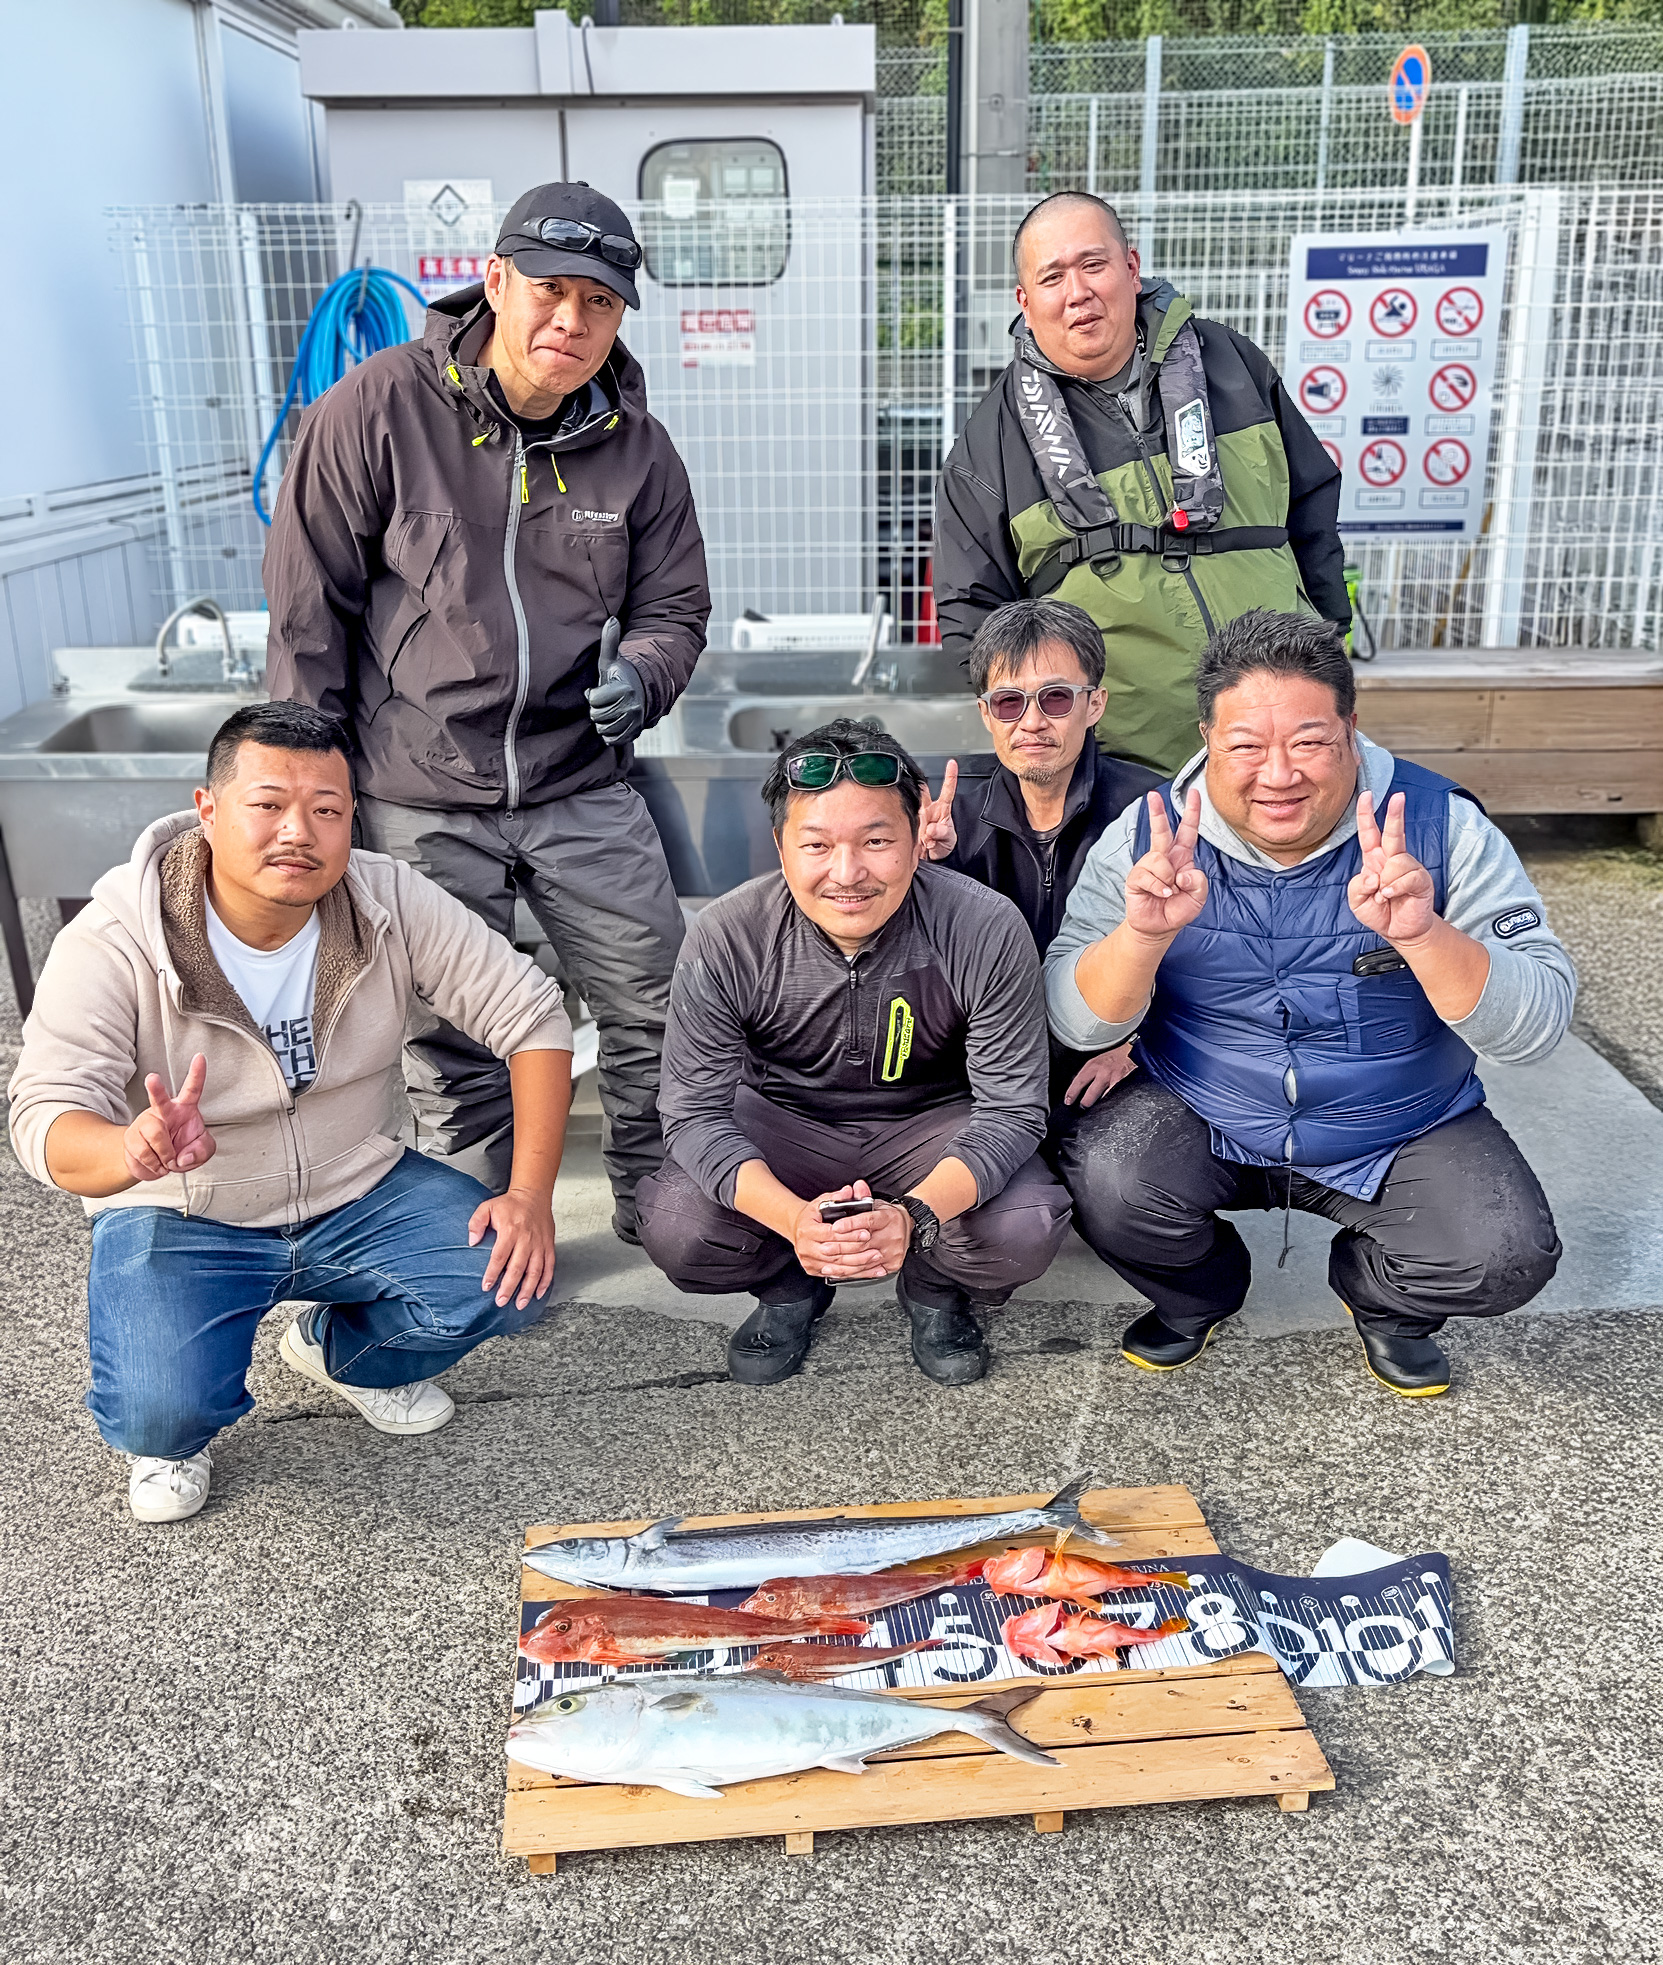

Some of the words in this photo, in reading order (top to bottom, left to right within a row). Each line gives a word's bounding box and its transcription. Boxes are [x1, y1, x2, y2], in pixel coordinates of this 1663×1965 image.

[1021, 369, 1072, 480] DAIWA
[261, 1016, 312, 1047] HE
[929, 1615, 998, 1683] 5
[1186, 1592, 1260, 1658] 8
[1256, 1610, 1321, 1684] 9
[1313, 1614, 1423, 1686] 10
